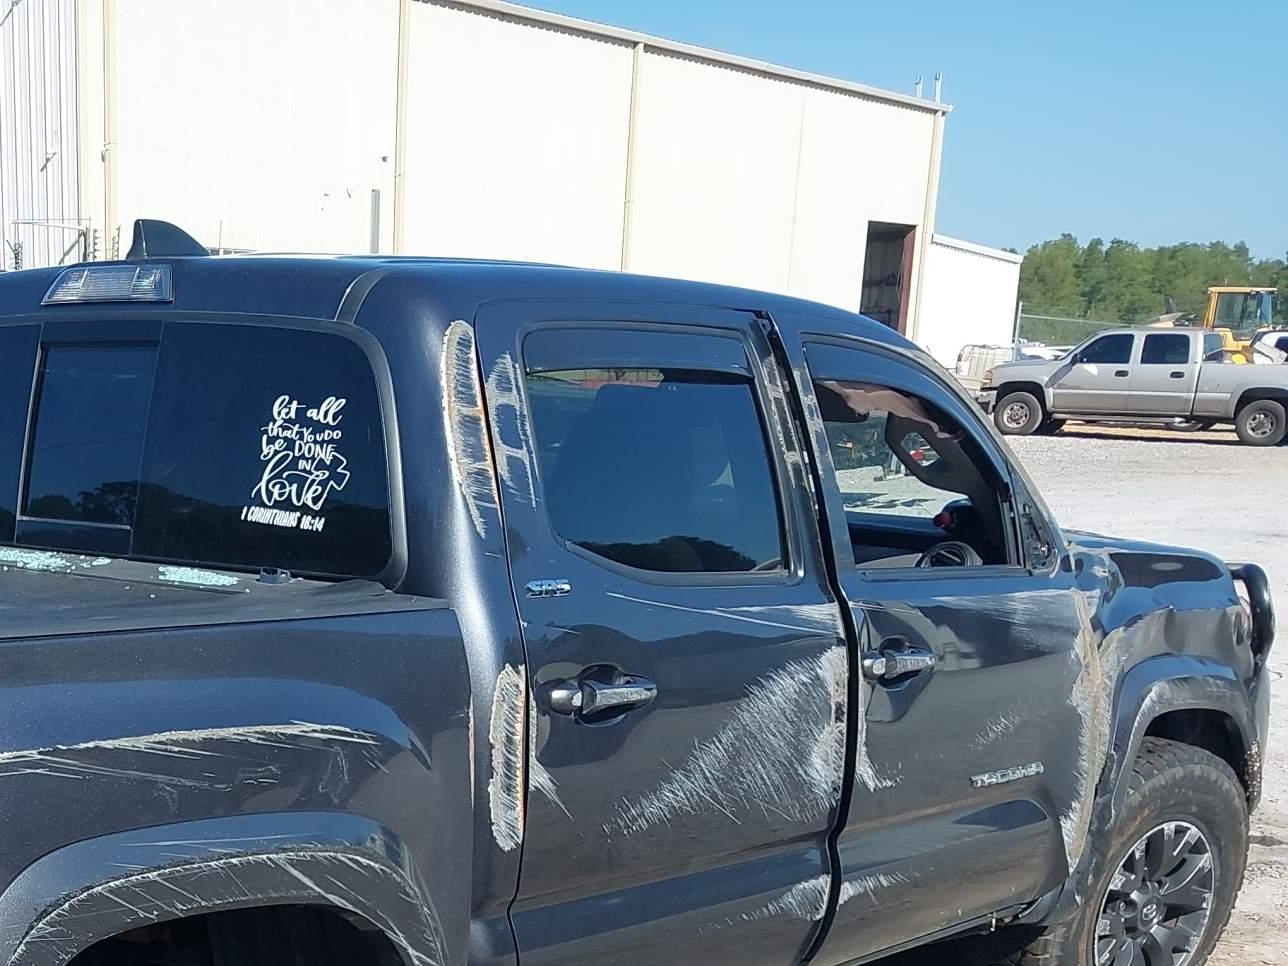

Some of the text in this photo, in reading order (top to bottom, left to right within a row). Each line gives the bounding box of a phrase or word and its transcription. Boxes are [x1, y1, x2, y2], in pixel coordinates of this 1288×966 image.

[306, 396, 346, 426] all
[261, 419, 304, 440] that
[260, 434, 337, 461] be DONE
[251, 450, 328, 507] love
[298, 459, 312, 471] IN
[247, 506, 301, 527] CORINTHIANS
[299, 514, 326, 532] 16:14
[970, 761, 1044, 788] TACOMA
